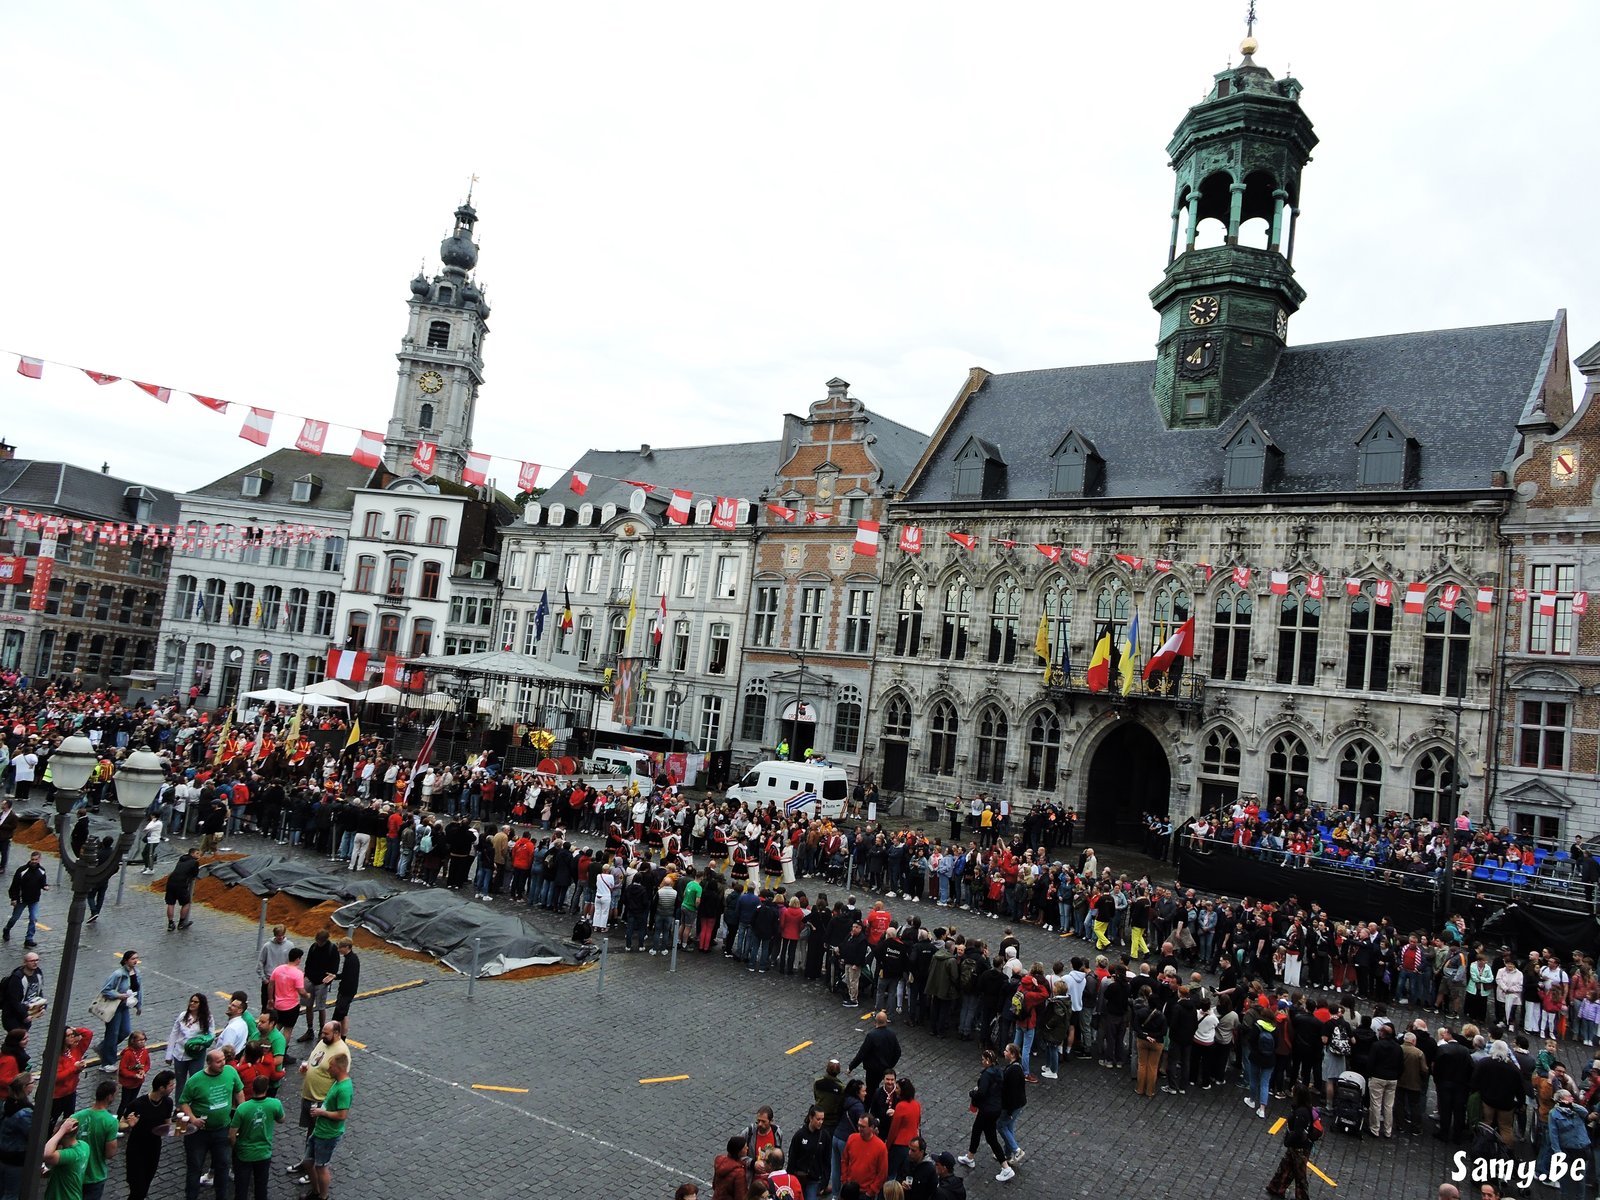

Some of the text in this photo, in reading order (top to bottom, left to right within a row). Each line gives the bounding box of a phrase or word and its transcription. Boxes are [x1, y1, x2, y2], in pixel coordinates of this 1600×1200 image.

[297, 440, 321, 451] MONS
[519, 479, 532, 488] ONS
[713, 518, 733, 527] MONS
[901, 541, 919, 550] MONS
